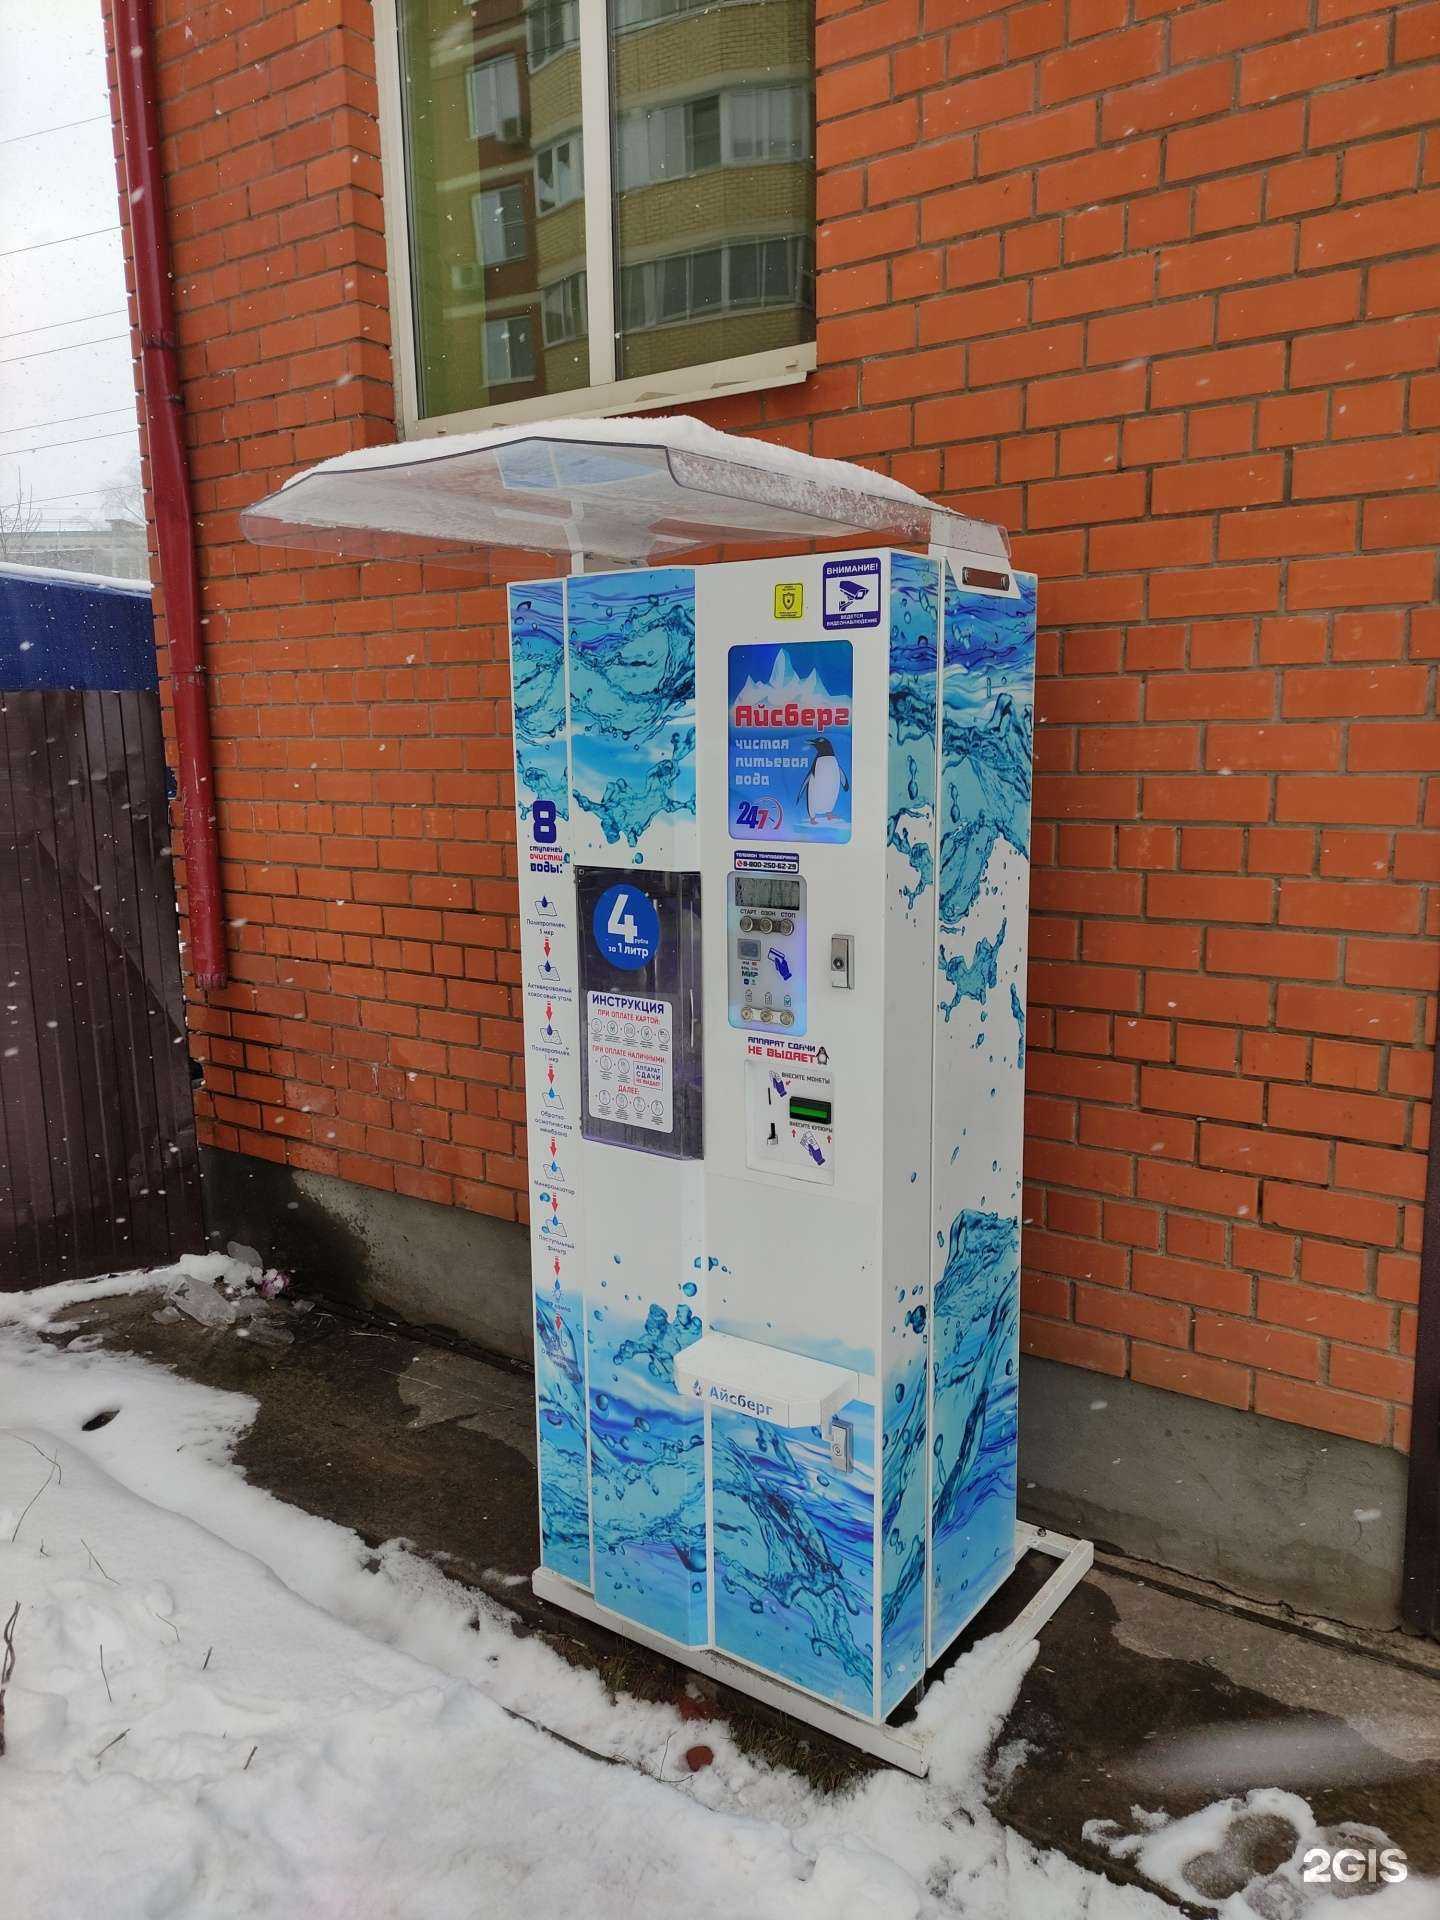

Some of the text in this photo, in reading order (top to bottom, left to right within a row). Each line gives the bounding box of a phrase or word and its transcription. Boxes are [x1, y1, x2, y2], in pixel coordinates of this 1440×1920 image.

[826, 563, 878, 575] ВНИМАНИЕ!
[826, 618, 878, 627] ВИДЕОНАБЛЮДЕНИЕ
[735, 703, 849, 731] Айсберг
[735, 739, 790, 750] чистая
[735, 757, 809, 768] питьевая
[735, 773, 770, 785] вода
[533, 800, 556, 843] 8
[529, 845, 563, 853] ступеней
[529, 853, 563, 862] очистки
[530, 861, 563, 873] воды:
[608, 893, 637, 943] 4
[740, 908, 757, 916] СТАРТ
[780, 911, 796, 919] СТОП
[618, 943, 623, 953] 1
[624, 946, 649, 959] литр
[592, 993, 665, 1014] ИНСТРУКЦИЯ
[597, 1008, 610, 1016] ПРИ
[611, 1011, 634, 1021] ОПЛАТЕ
[592, 1044, 604, 1053] ПРИ
[604, 1046, 627, 1057] ОПЛАТЕ
[747, 1036, 816, 1053] АППАРАТ СДАЧИ
[748, 1045, 816, 1064] НЕ ВЫДАЕТ
[635, 1064, 661, 1074] АППАРАТ
[636, 1071, 661, 1080] СДАЧИ
[781, 1071, 831, 1085] ВНЕСИТЕ МОНЕТЫ
[789, 1120, 833, 1134] ВНЕСИТЕ КУПЮРЫ
[709, 1385, 774, 1416] Айсберг
